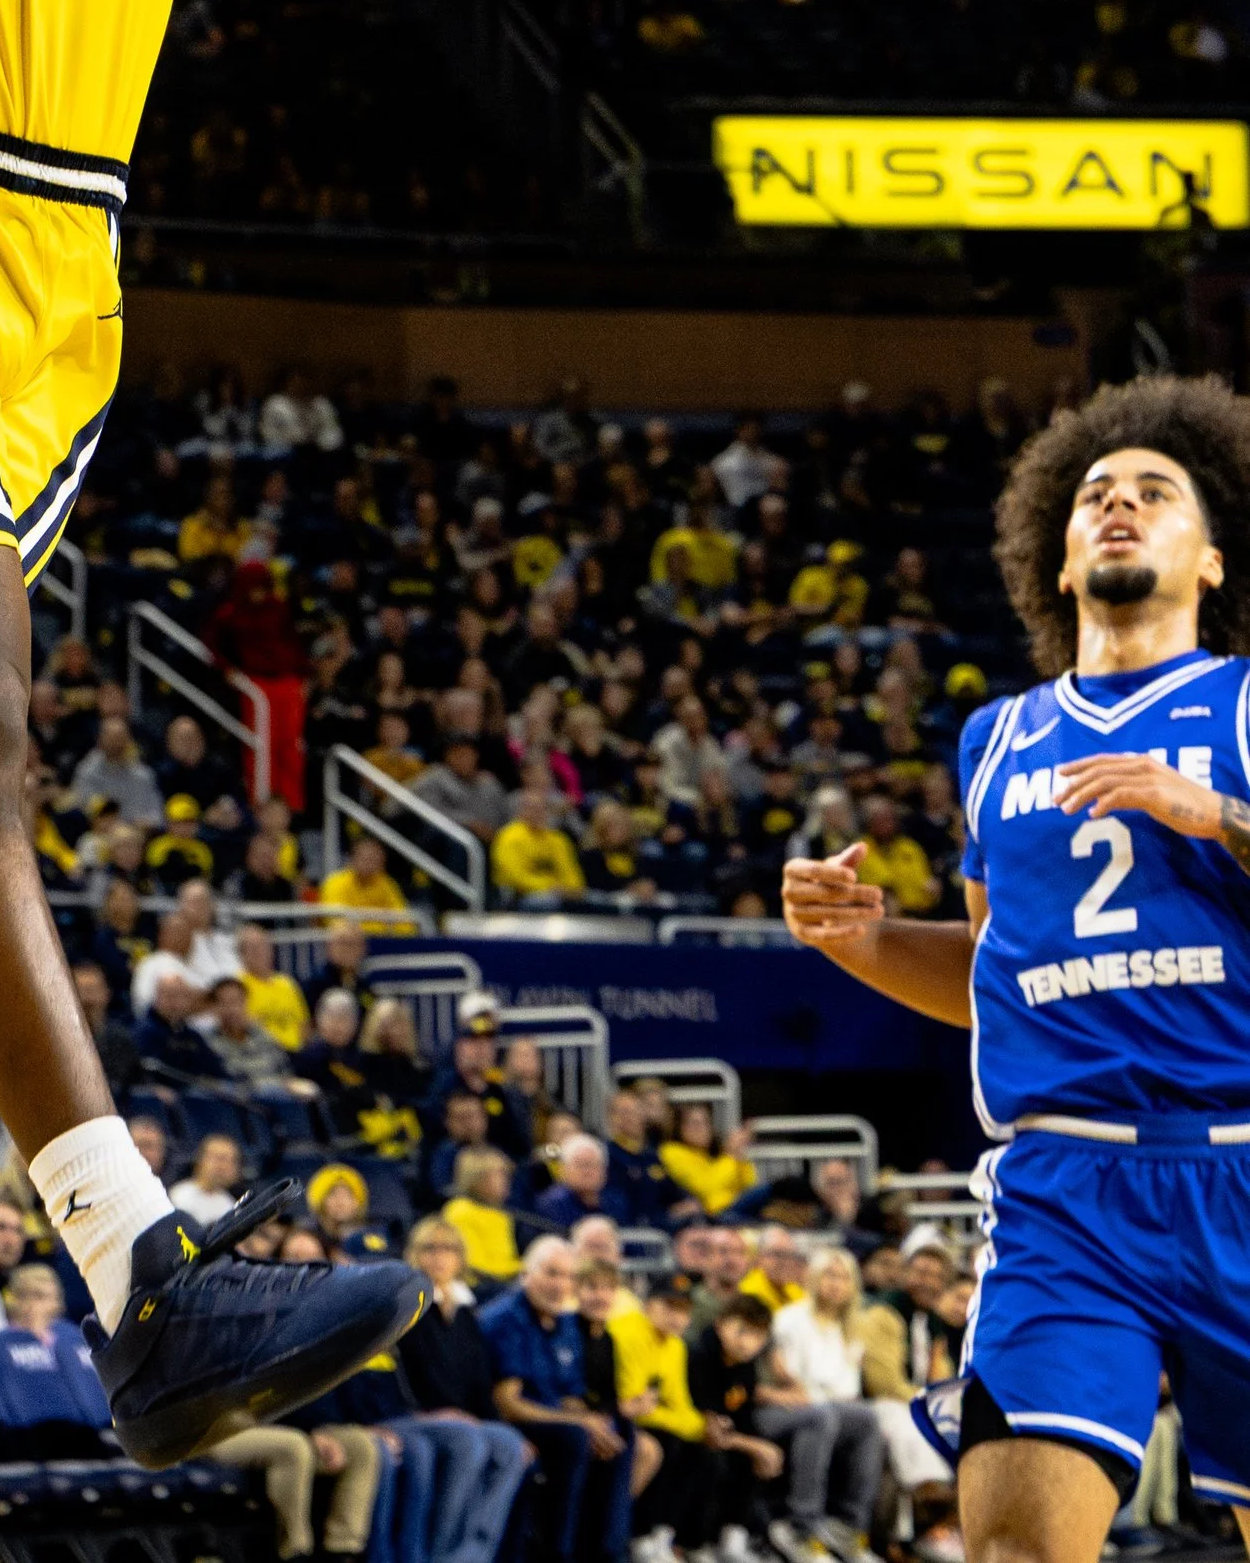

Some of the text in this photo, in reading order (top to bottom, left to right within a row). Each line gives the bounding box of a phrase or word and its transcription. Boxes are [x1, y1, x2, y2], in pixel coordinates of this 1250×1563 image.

[750, 146, 1213, 198] NISSAN
[1071, 816, 1138, 939] 2
[1016, 946, 1226, 1008] TENNESSEE
